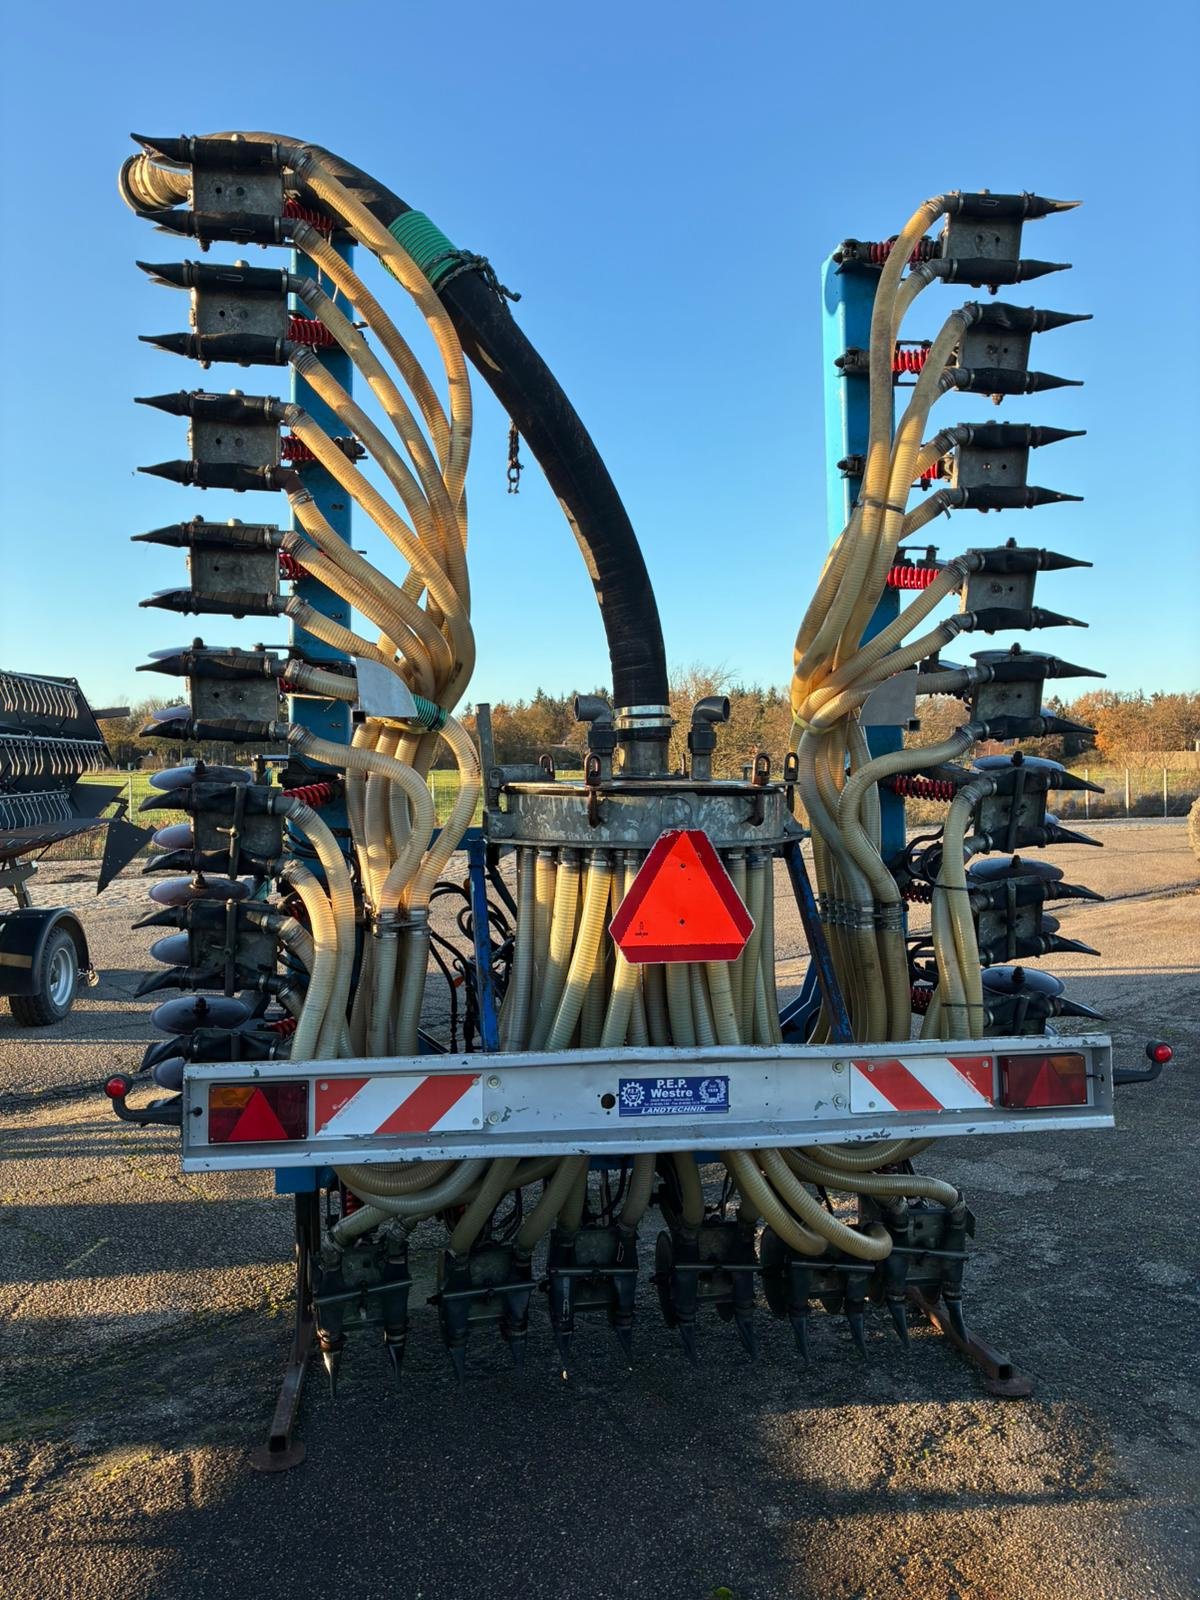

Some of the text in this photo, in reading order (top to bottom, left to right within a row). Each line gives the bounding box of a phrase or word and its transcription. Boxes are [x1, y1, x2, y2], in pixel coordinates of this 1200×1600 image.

[656, 1079, 688, 1089] P.E.P.
[650, 1088, 693, 1098] Westre
[641, 1105, 707, 1114] LANDTECHNIK
